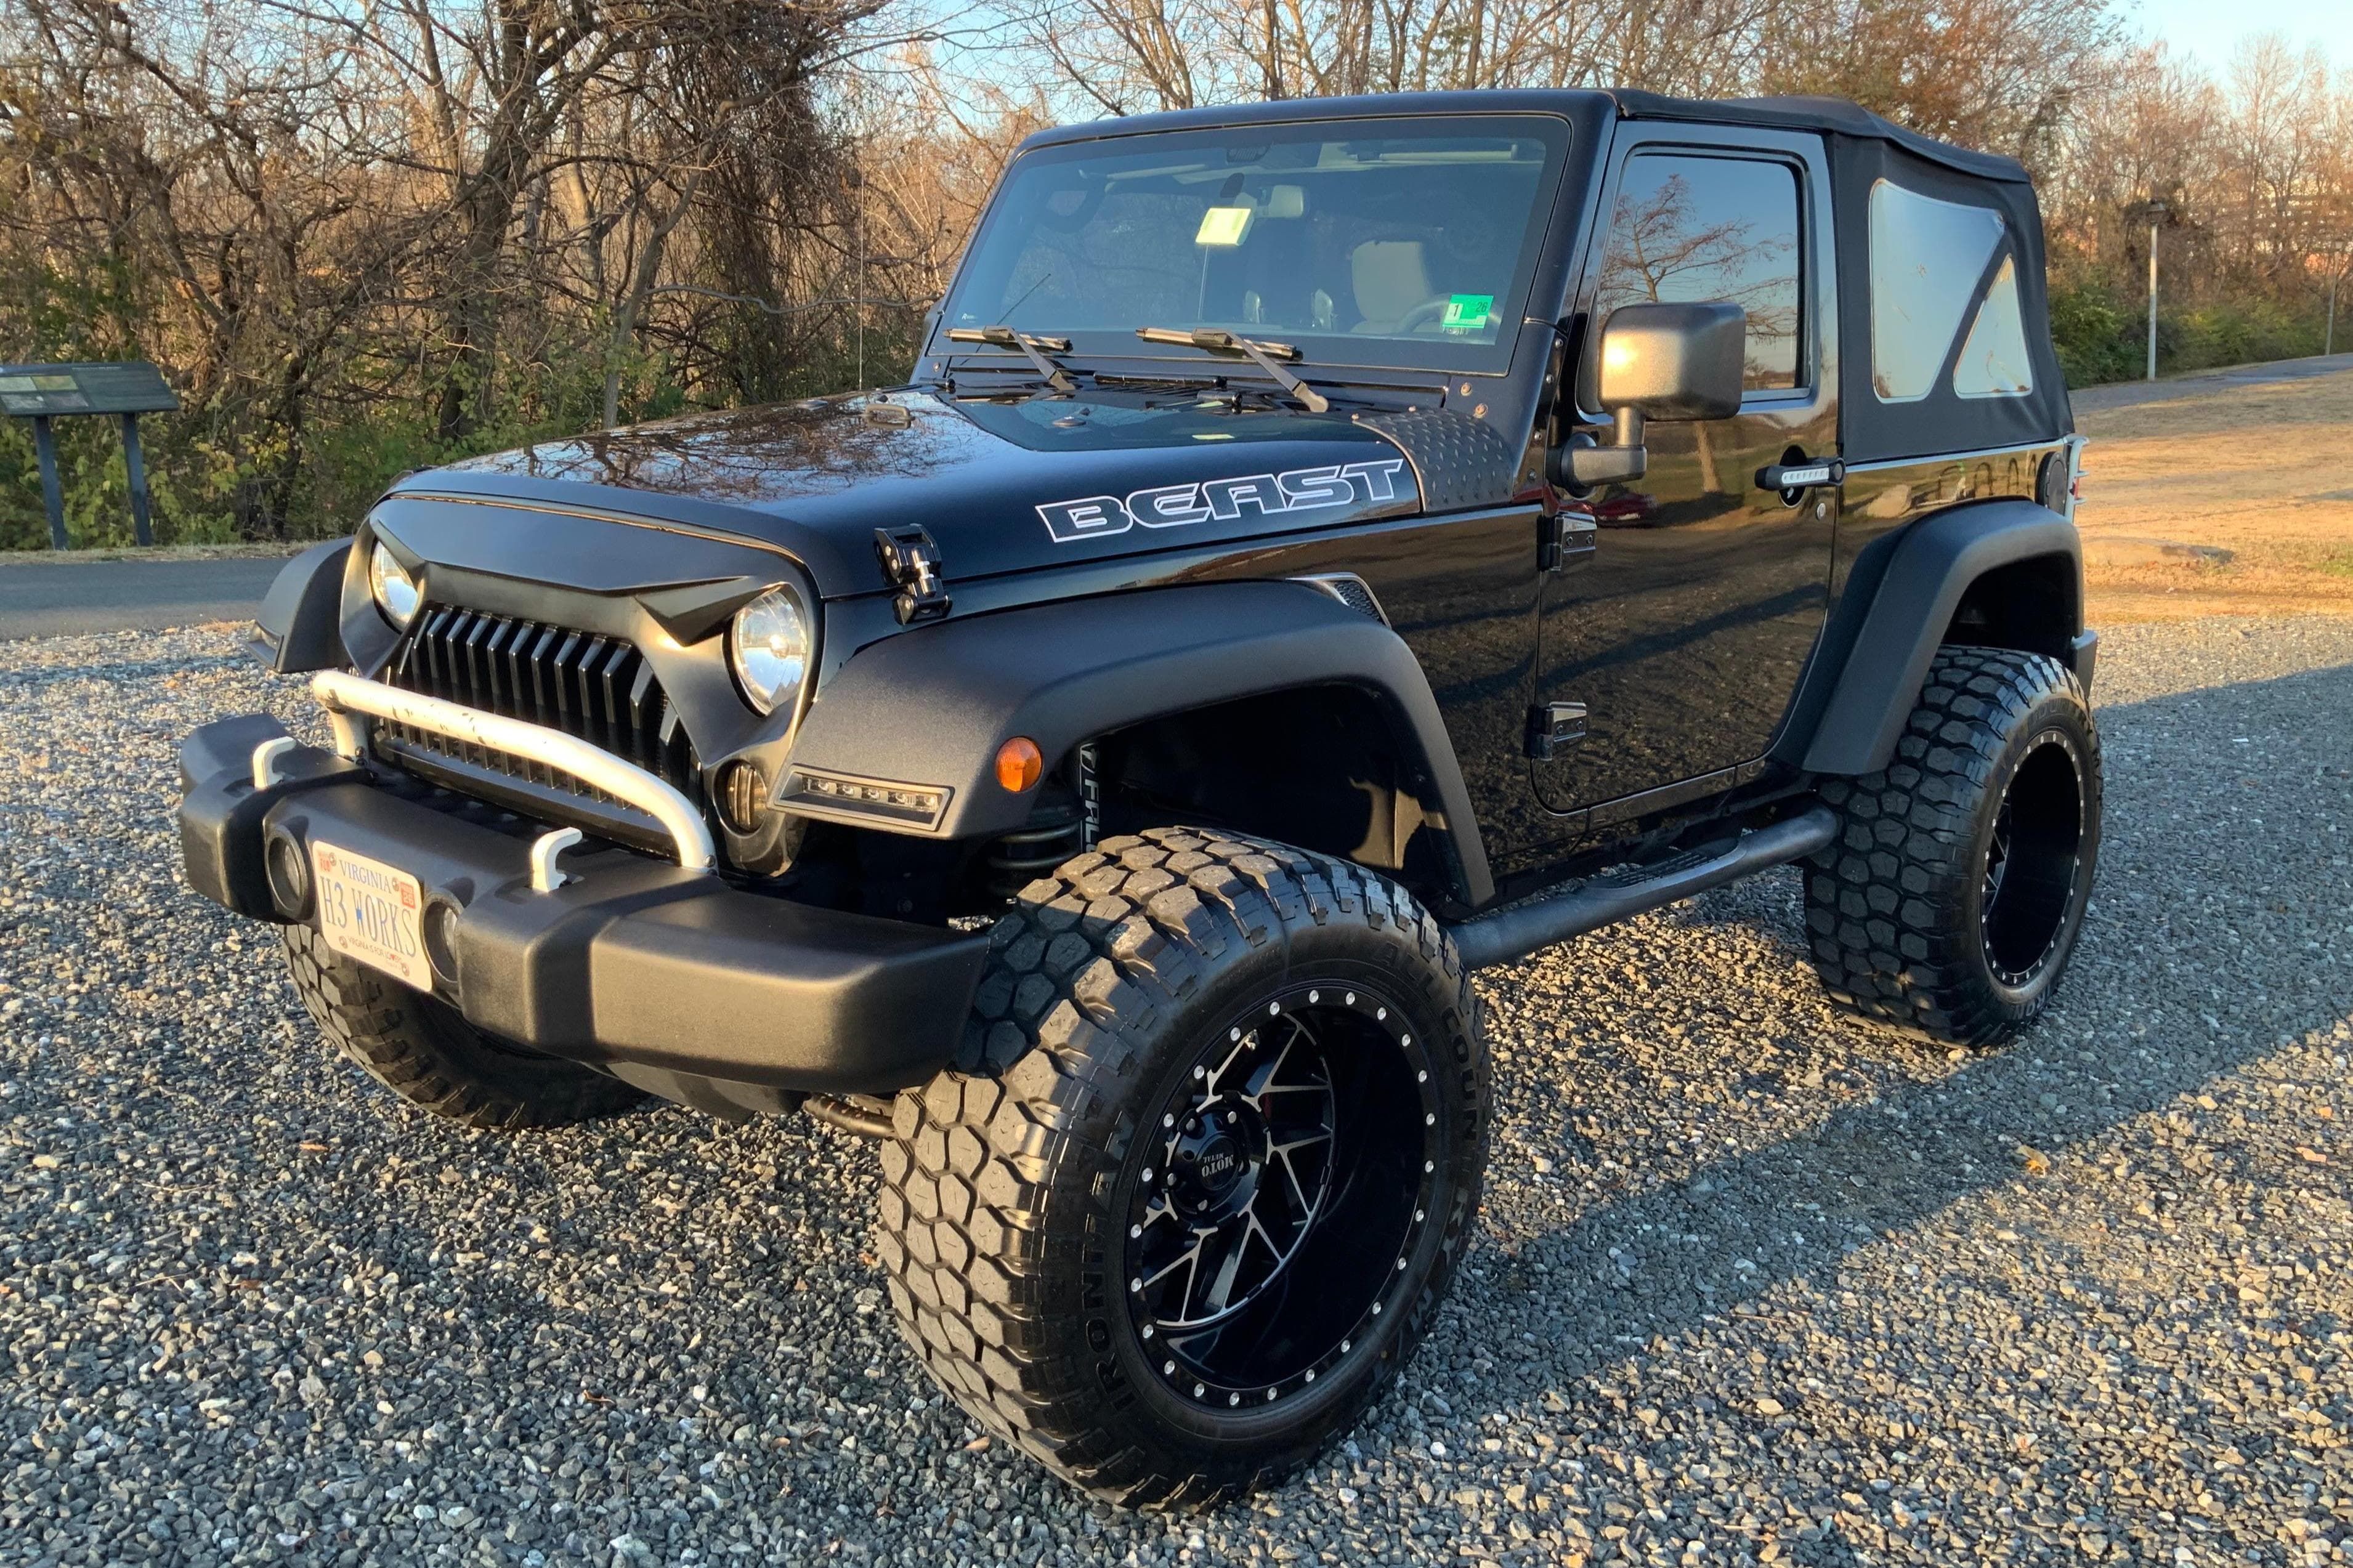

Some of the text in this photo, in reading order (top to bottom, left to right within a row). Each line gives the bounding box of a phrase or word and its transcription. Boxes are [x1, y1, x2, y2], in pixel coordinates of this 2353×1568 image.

[1454, 304, 1459, 317] 1
[1476, 302, 1488, 313] 26
[1035, 459, 1403, 542] BEAST
[339, 860, 392, 894] VIRGINIA
[320, 876, 416, 957] H3 WORKS
[1202, 1155, 1233, 1177] MOTO
